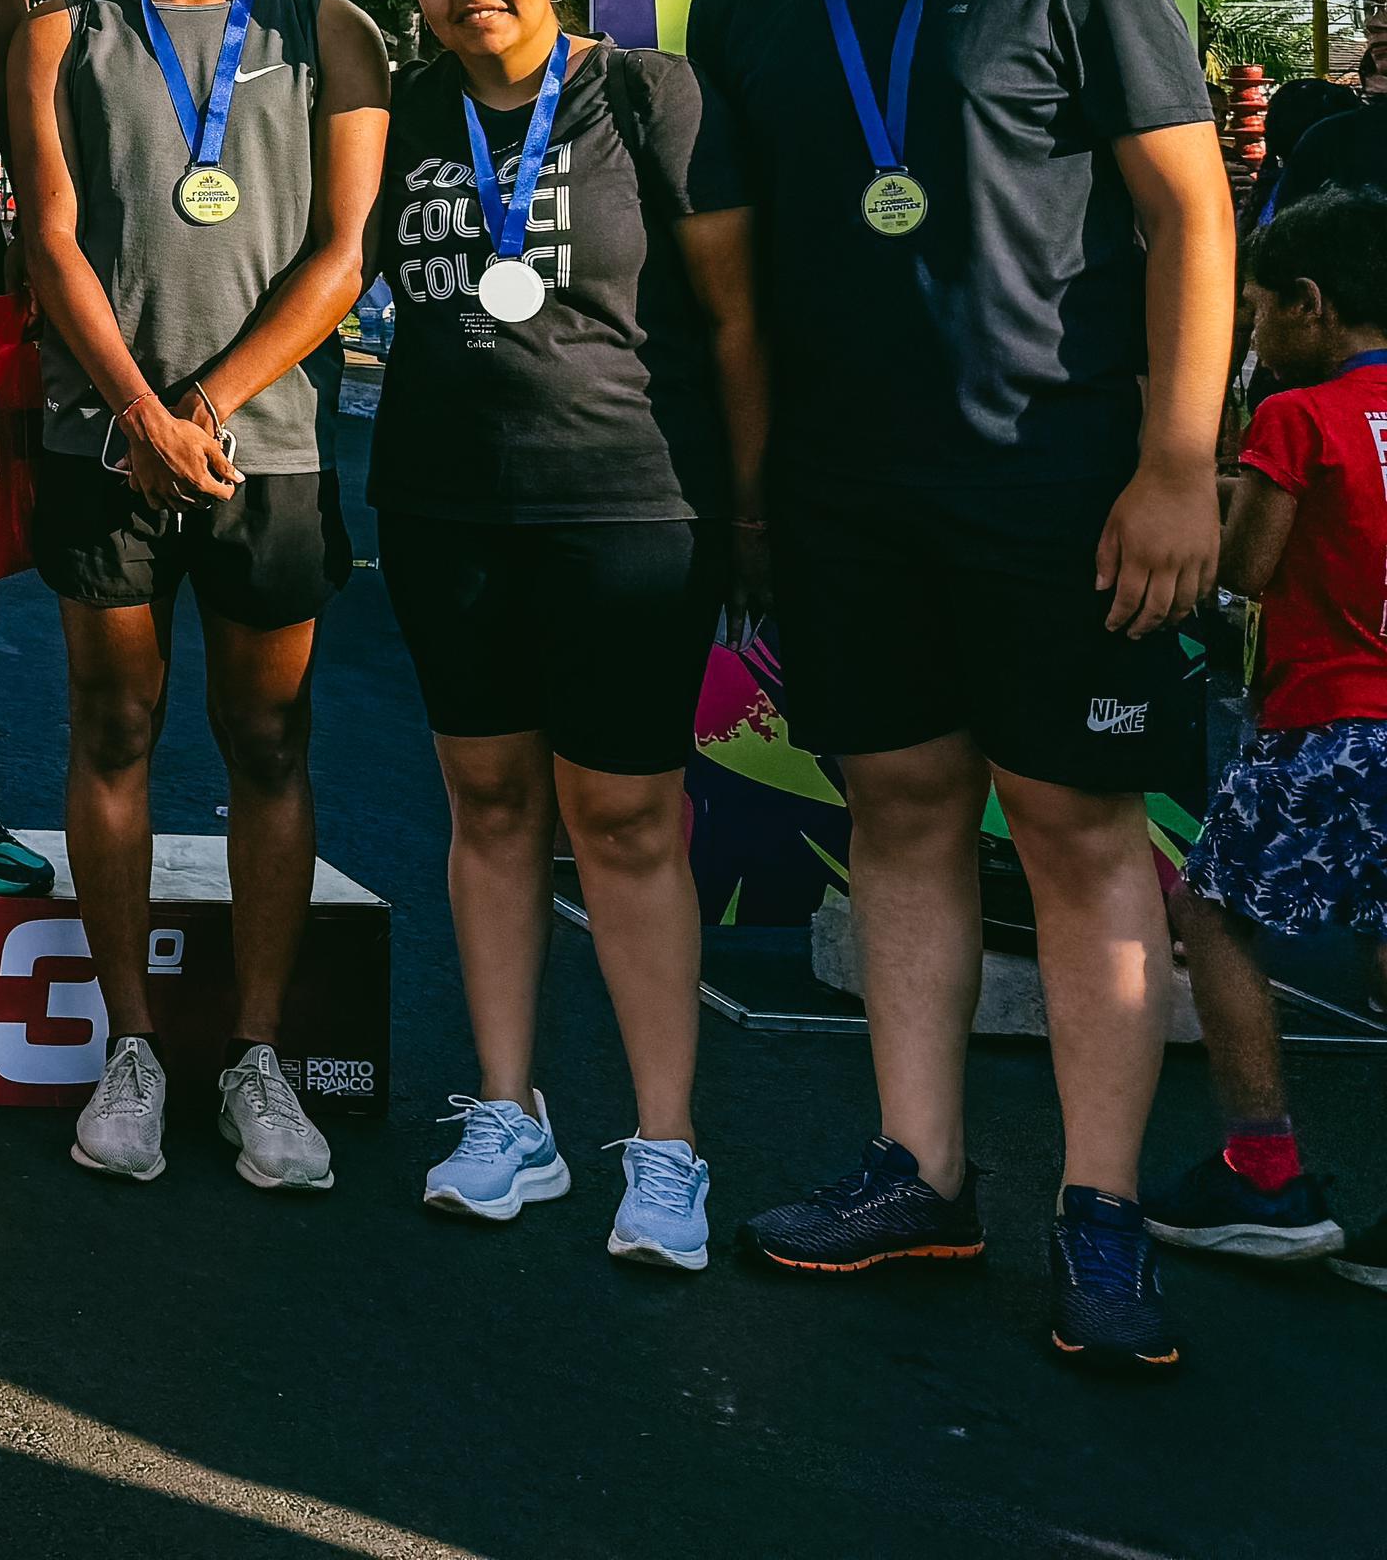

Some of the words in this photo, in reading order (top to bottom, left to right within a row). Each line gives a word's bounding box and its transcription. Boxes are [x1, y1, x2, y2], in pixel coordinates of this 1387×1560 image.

[1088, 698, 1148, 734] NIKE
[307, 1060, 374, 1077] PORTO
[307, 1076, 374, 1093] FRANCO
